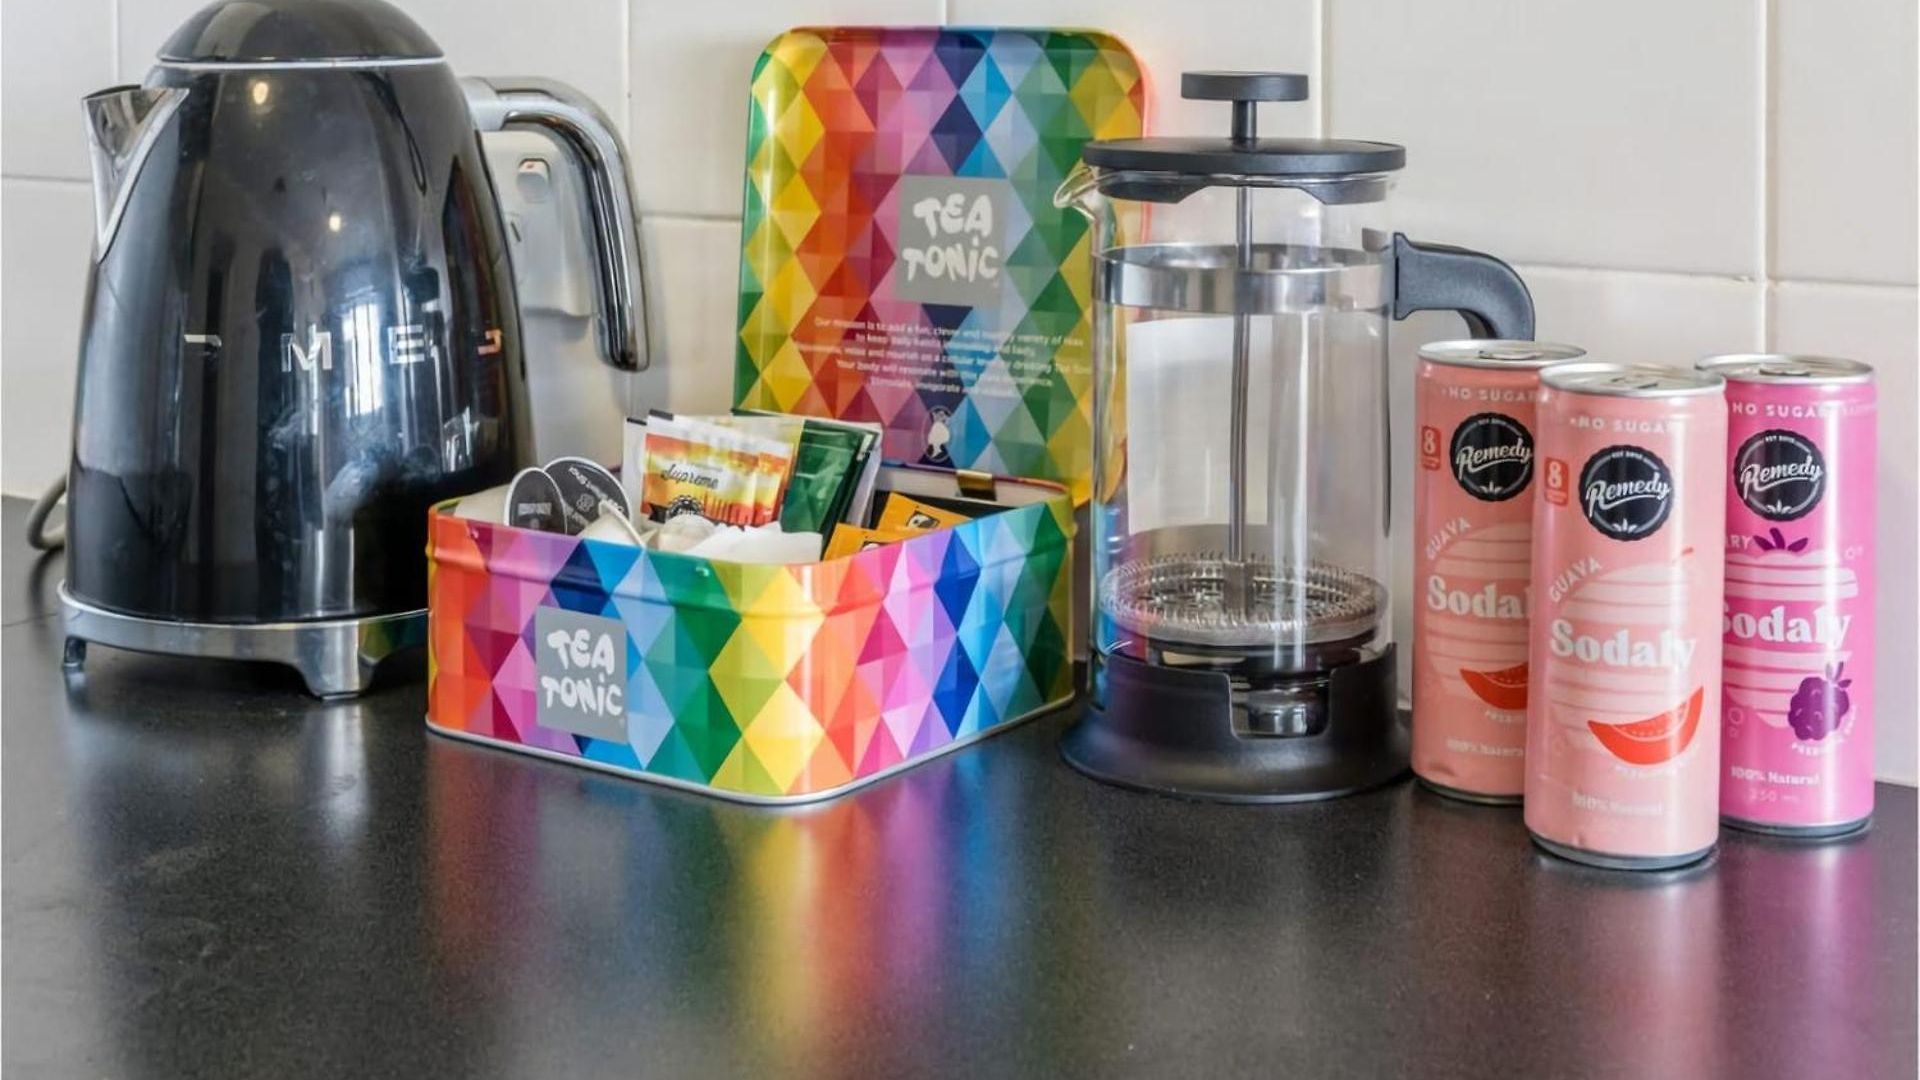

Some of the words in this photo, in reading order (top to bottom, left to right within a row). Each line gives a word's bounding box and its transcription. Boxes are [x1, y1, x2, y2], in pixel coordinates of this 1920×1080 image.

[913, 193, 993, 239] TEA
[184, 324, 503, 373] ME
[1448, 387, 1472, 400] NO
[1732, 403, 1757, 416] NO
[1766, 403, 1823, 419] SUGA
[1424, 429, 1436, 454] 8
[1579, 415, 1605, 430] NO
[1613, 419, 1670, 433] SUGA
[660, 463, 720, 490] Supreme
[1456, 437, 1534, 480] Remedy
[1548, 461, 1562, 488] 8
[1740, 454, 1823, 500] Remedy
[1585, 471, 1671, 518] Remedy
[1427, 517, 1471, 560] GUAVA
[1550, 556, 1602, 602] GUAVA
[547, 628, 615, 676] TEA
[1551, 618, 1697, 670] Sodaly
[1768, 771, 1821, 786] Natural
